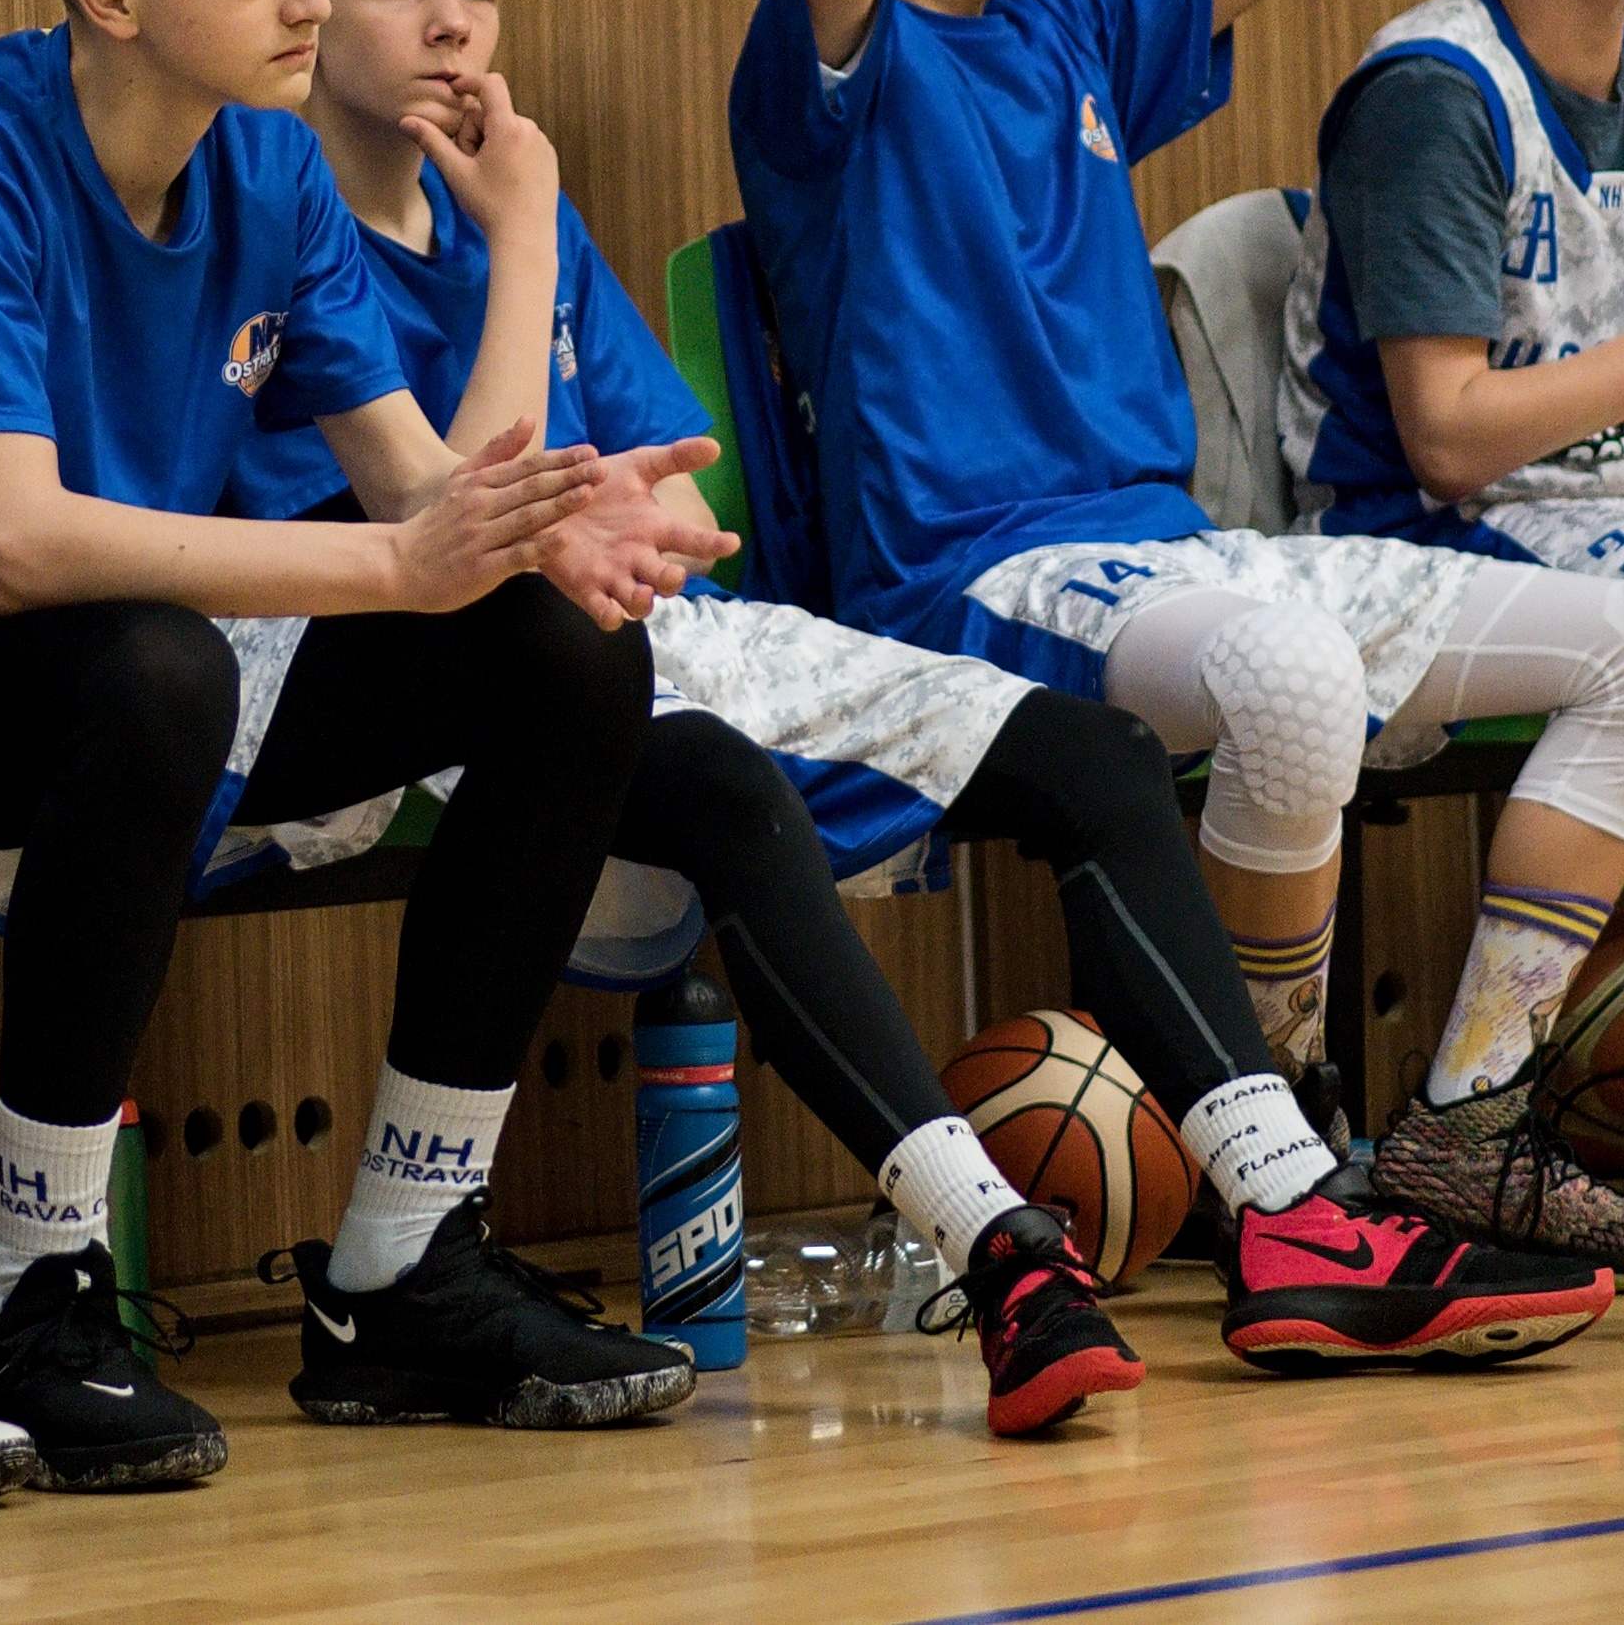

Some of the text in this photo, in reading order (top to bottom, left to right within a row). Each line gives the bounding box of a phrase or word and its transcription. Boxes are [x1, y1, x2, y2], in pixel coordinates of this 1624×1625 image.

[1599, 185, 1623, 209] NH
[1059, 559, 1157, 607] 14
[380, 1121, 474, 1167] NH
[647, 1167, 744, 1290] SPO
